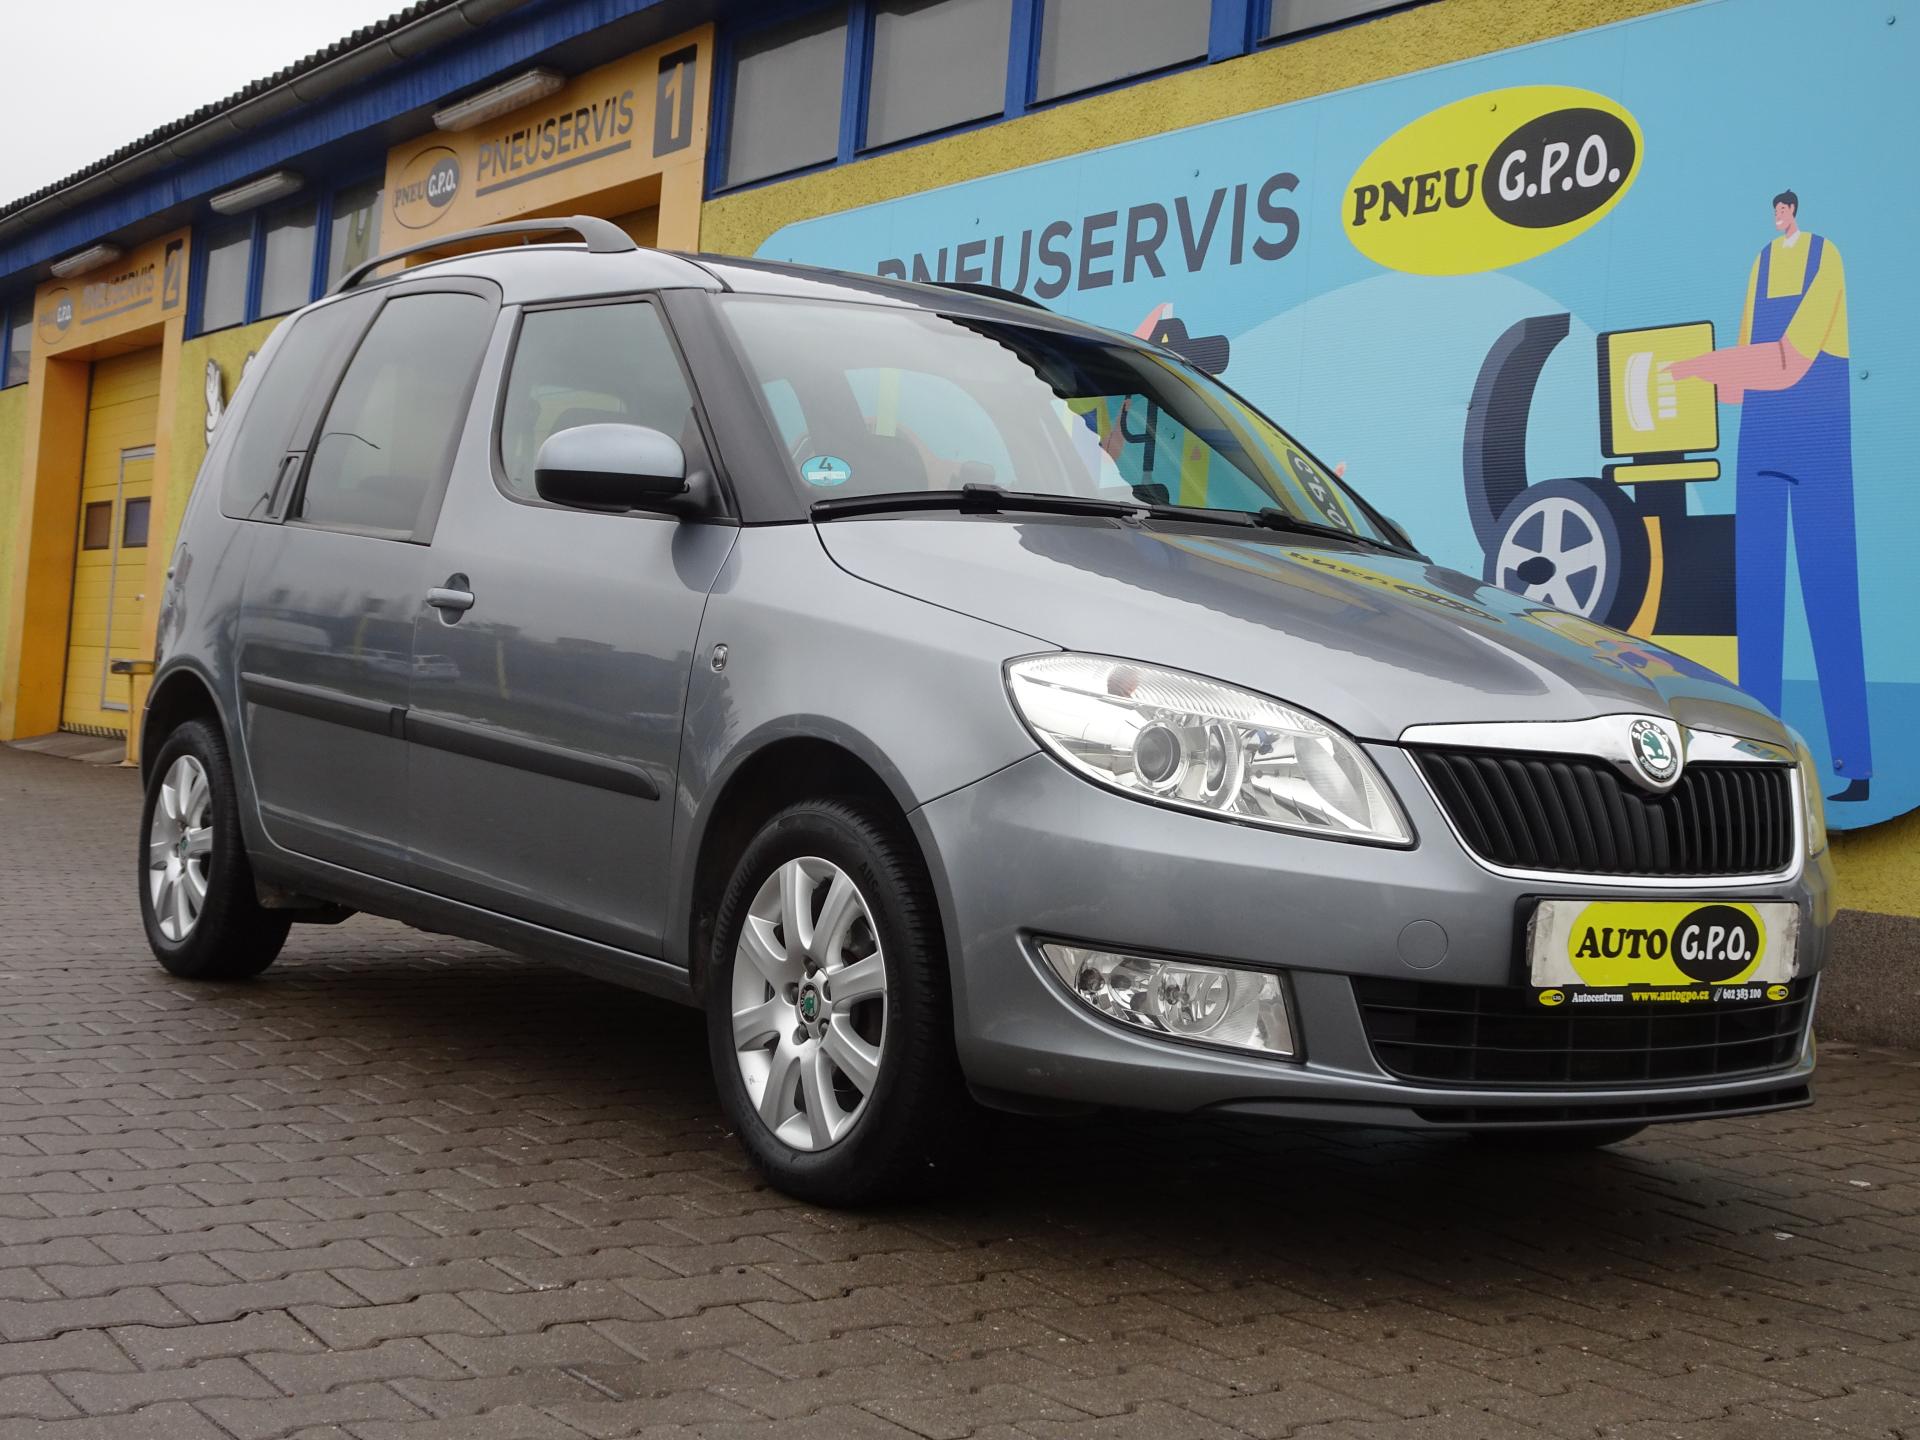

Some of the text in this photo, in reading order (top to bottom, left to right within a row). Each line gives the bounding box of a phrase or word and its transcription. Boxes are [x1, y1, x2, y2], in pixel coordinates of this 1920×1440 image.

[664, 61, 685, 140] 1
[476, 90, 635, 182] PNEUSERVIS
[393, 168, 457, 208] PNEU G.P.O.
[1352, 134, 1621, 226] PNEU G.P.O.
[164, 248, 179, 302] 2
[1575, 925, 1751, 961] AUTO G.P.O.
[1571, 992, 1624, 1003] Autocentrum
[1631, 989, 1710, 1003] www.autogpo.cz
